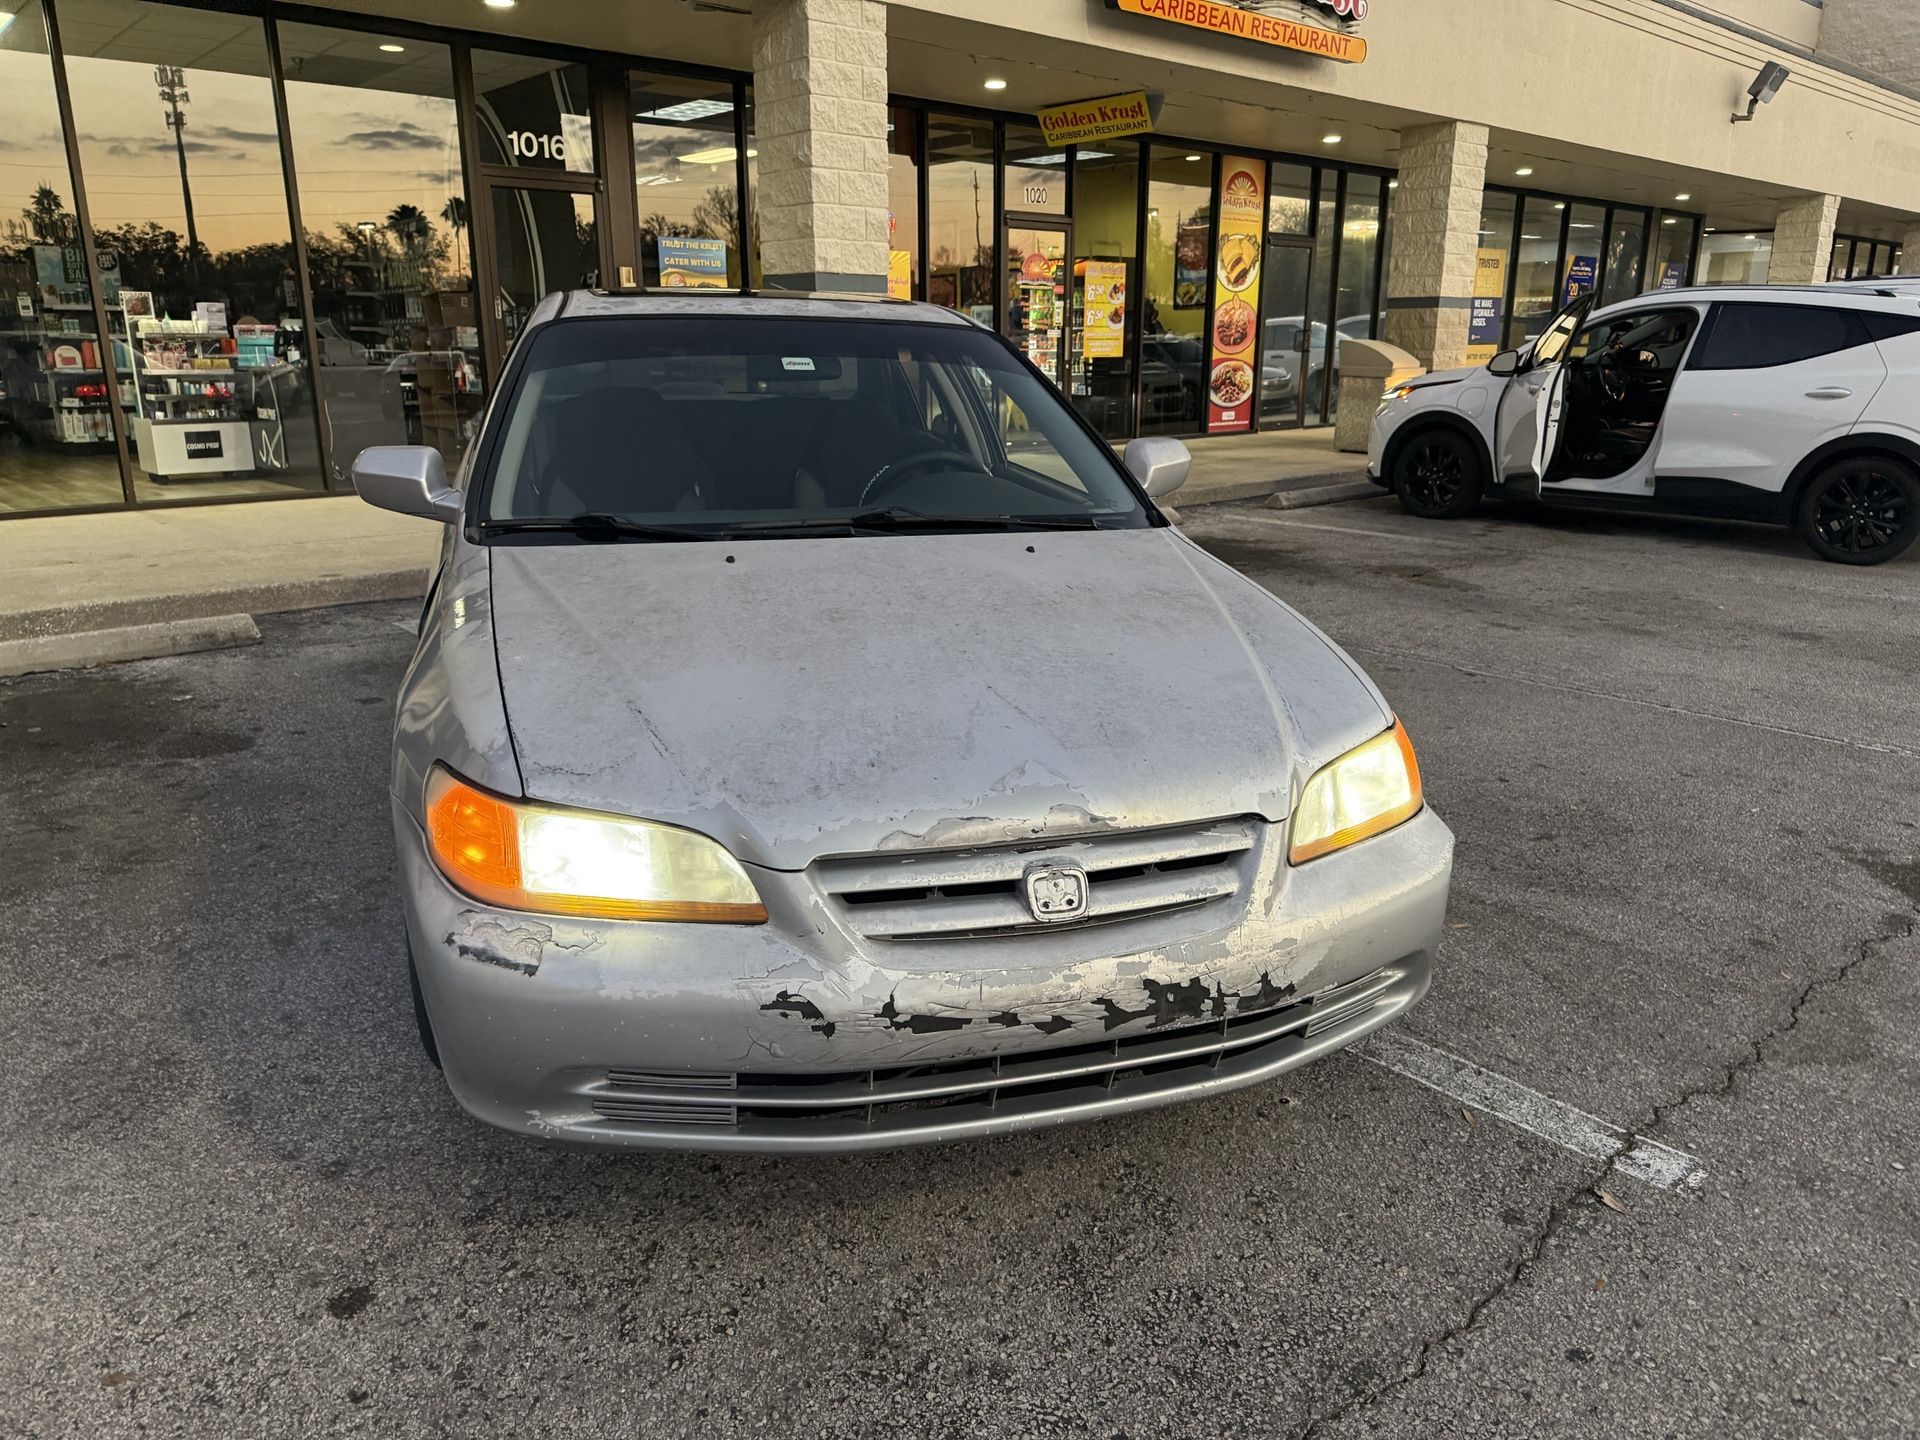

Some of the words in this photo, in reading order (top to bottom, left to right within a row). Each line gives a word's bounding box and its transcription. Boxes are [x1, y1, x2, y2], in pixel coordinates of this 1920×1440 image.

[1140, 0, 1245, 33] CARIBBEAN
[1251, 17, 1352, 56] RESTAURANT
[1043, 111, 1098, 131] Golden
[1097, 101, 1147, 122] Krust
[1048, 128, 1094, 142] CARIBBEAN
[1095, 119, 1148, 135] RESTAURANT
[507, 130, 565, 160] 1016
[1026, 187, 1047, 204] 1020
[662, 240, 684, 249] TRUST
[664, 257, 689, 266] CATER
[690, 258, 710, 267] WITH
[711, 259, 721, 267] US
[1479, 259, 1501, 269] TRUSTED
